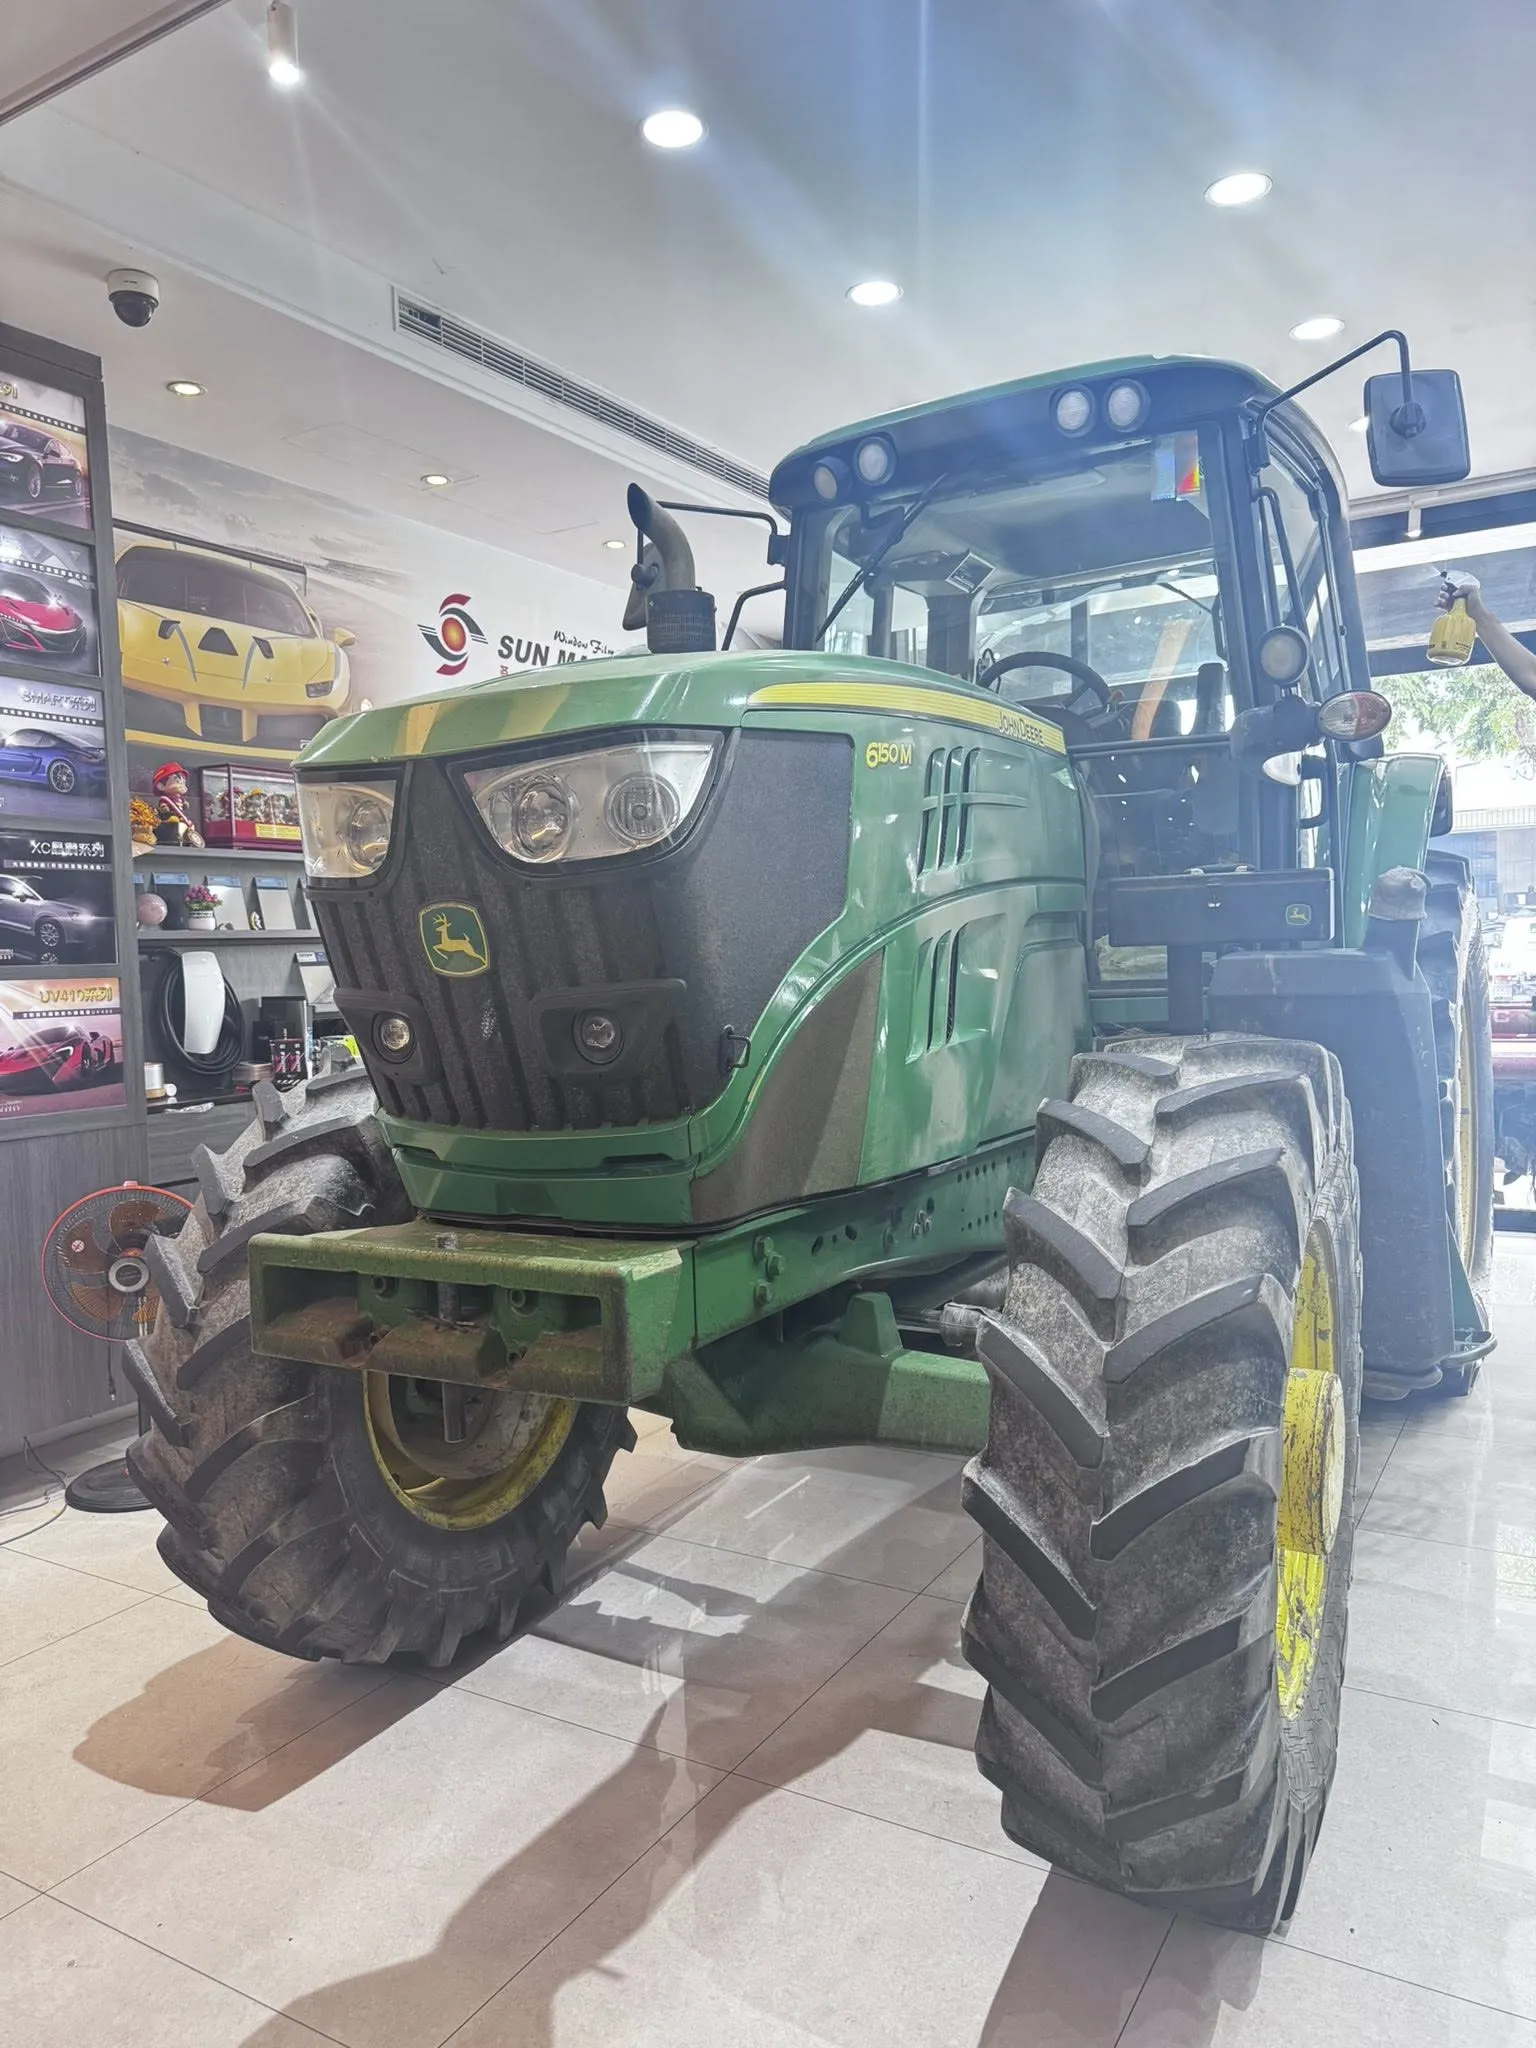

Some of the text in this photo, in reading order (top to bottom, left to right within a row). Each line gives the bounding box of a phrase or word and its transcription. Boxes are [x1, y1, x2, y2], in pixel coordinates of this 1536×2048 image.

[497, 635, 588, 666] SUN M
[553, 630, 614, 655] Window Film
[999, 711, 1045, 747] JOHN DEERE
[865, 742, 912, 769] 6150M
[40, 987, 113, 1003] UV410系列
